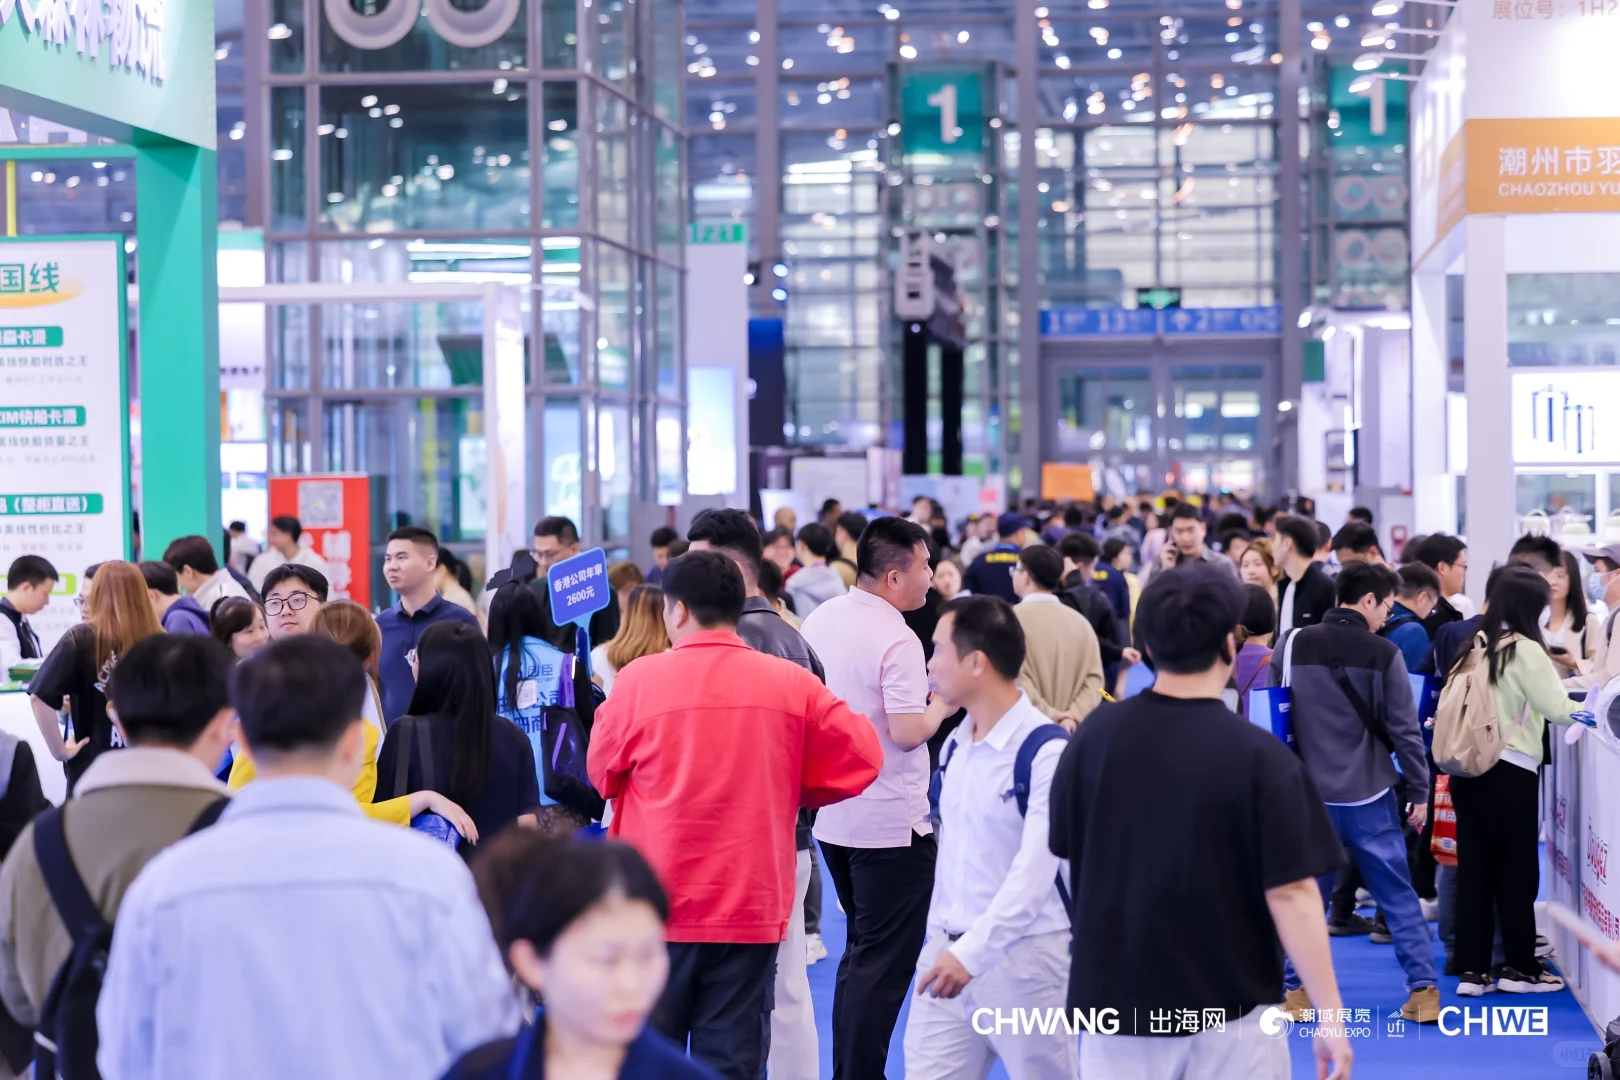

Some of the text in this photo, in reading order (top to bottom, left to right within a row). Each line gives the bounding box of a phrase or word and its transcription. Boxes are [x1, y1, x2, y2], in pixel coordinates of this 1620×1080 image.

[926, 83, 960, 144] 1
[1498, 145, 1620, 176] 潮州市羽
[1498, 181, 1595, 197] CHAOZHOU
[0, 523, 85, 535] 美线性价比之王
[566, 585, 595, 606] 2600元
